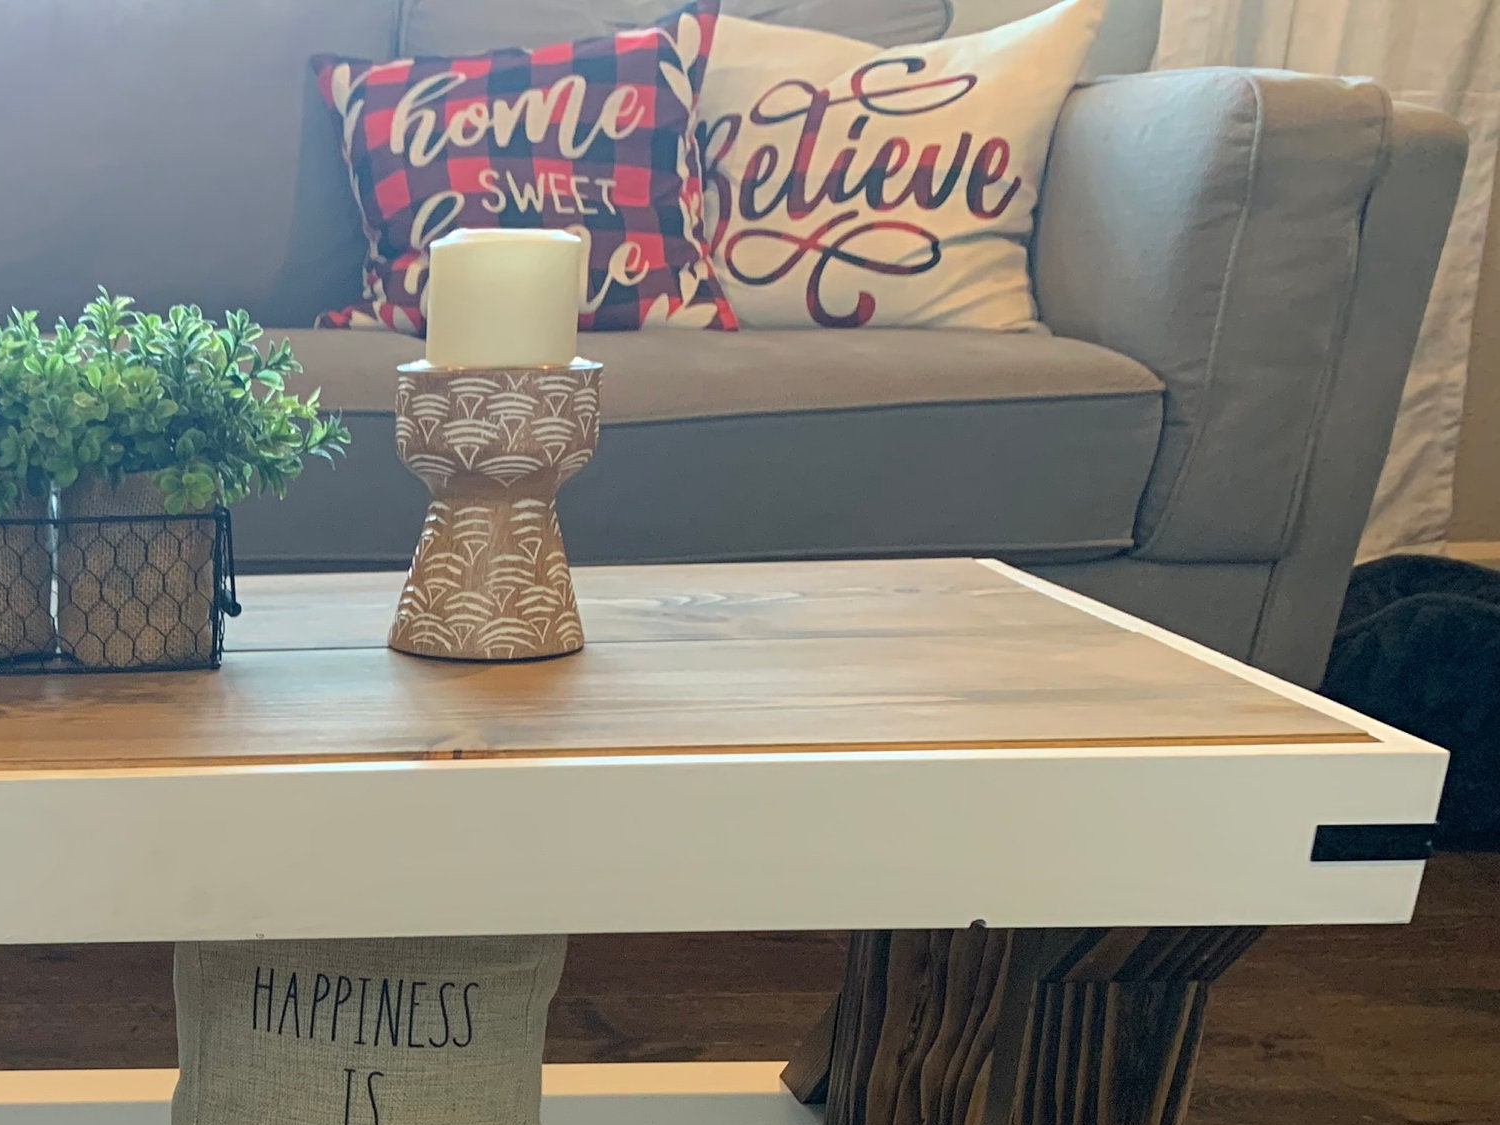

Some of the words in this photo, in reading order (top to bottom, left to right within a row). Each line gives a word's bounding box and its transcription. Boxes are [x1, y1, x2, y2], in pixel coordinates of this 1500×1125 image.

[390, 71, 646, 168] home
[478, 168, 618, 216] SWEET
[253, 966, 480, 1048] HAPPINESS
